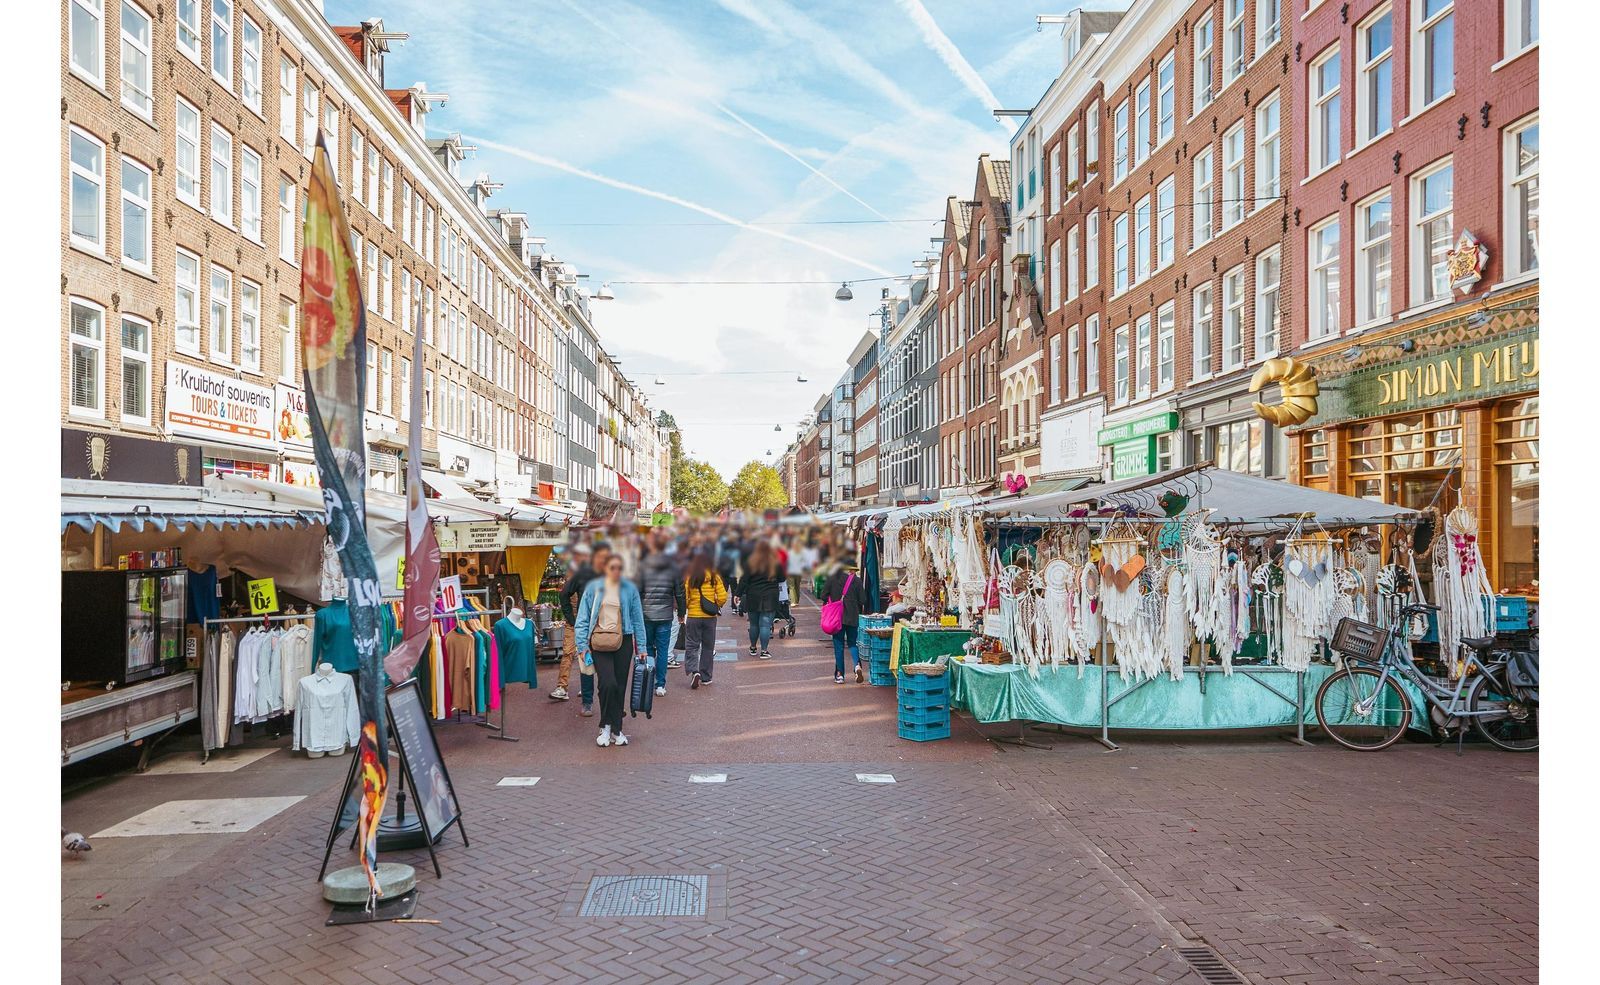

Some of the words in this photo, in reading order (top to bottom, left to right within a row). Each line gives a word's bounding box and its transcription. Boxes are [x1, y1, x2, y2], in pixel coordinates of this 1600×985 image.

[180, 368, 225, 397] Kruithof
[227, 386, 271, 409] souvenirs
[1377, 357, 1462, 405] SIMON
[191, 394, 218, 416] TOURS
[219, 401, 225, 418] &
[227, 402, 257, 425] TICKETS
[1115, 453, 1147, 476] GRIMME
[186, 638, 195, 656] 1759
